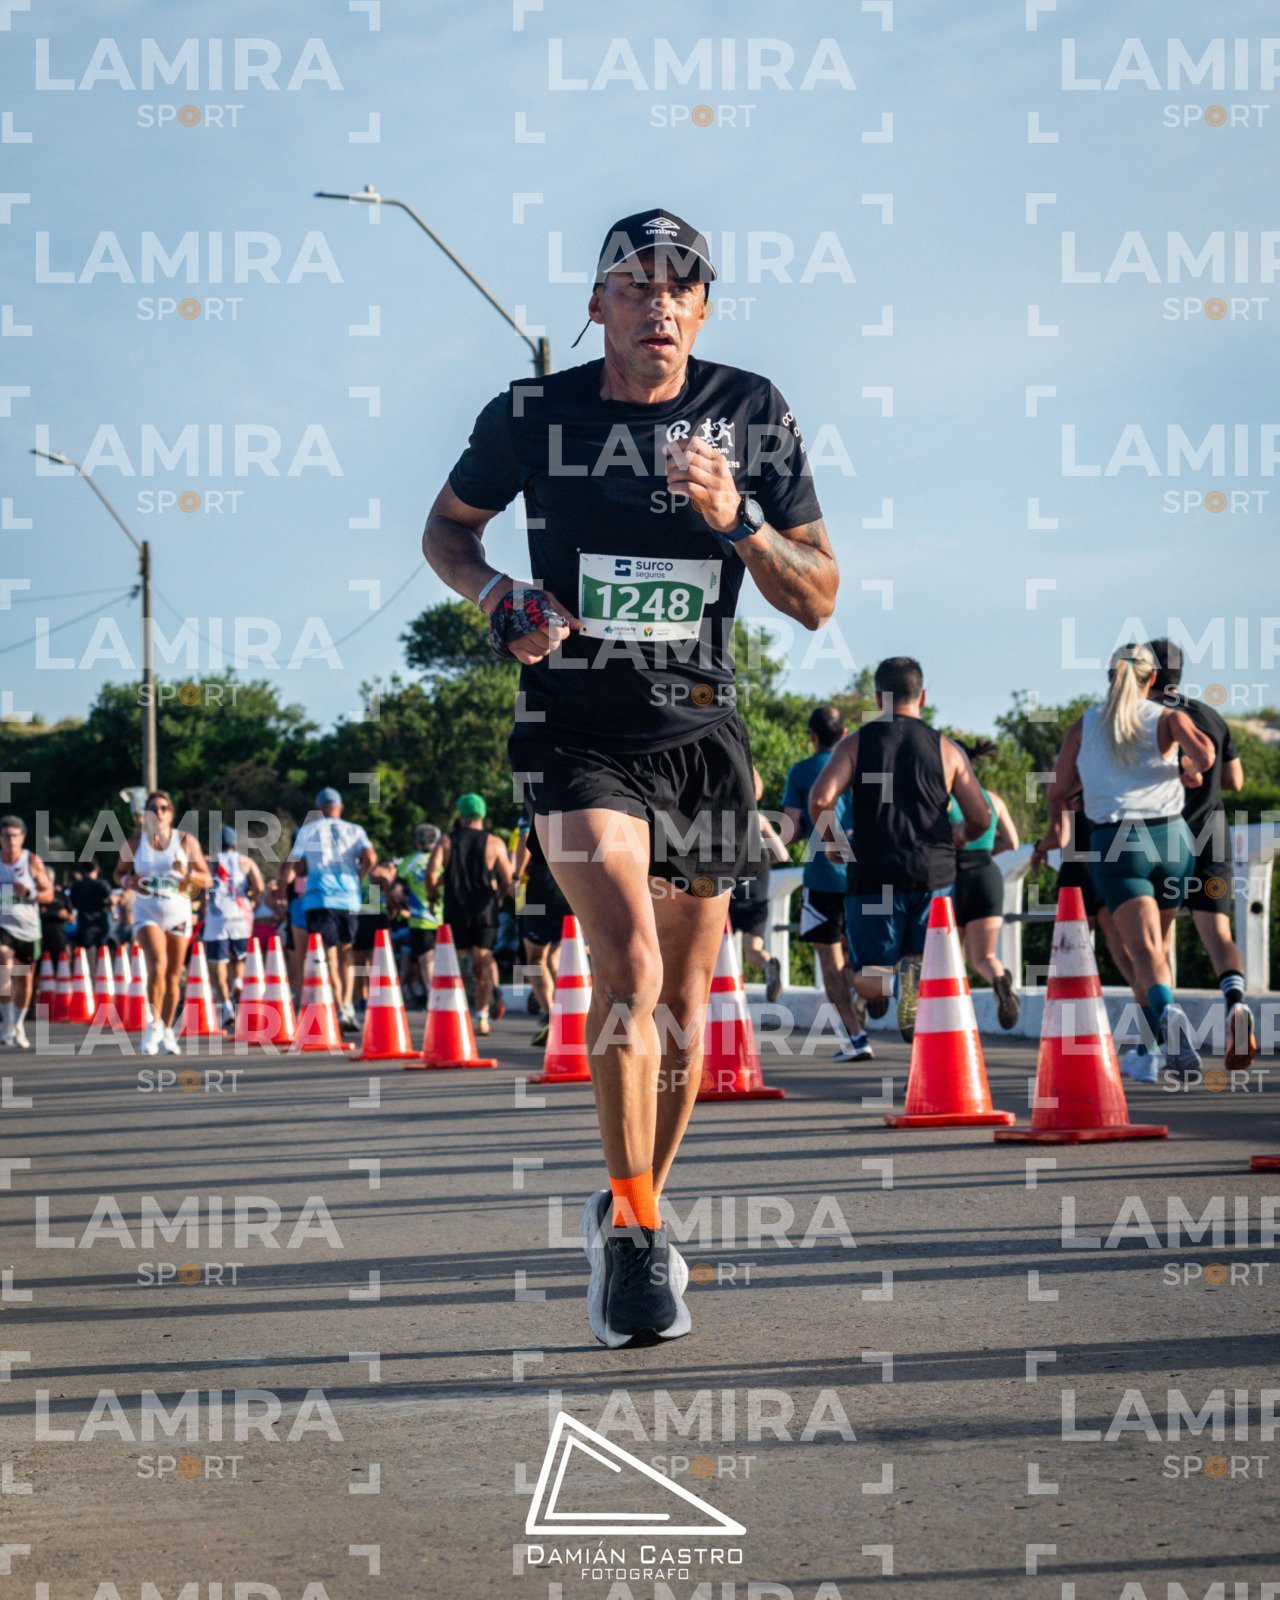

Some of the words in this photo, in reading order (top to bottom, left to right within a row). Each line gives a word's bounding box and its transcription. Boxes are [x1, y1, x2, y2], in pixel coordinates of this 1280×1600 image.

[645, 228, 678, 237] umbro
[635, 560, 674, 572] surco
[635, 571, 666, 580] seguros
[596, 584, 691, 621] 1248
